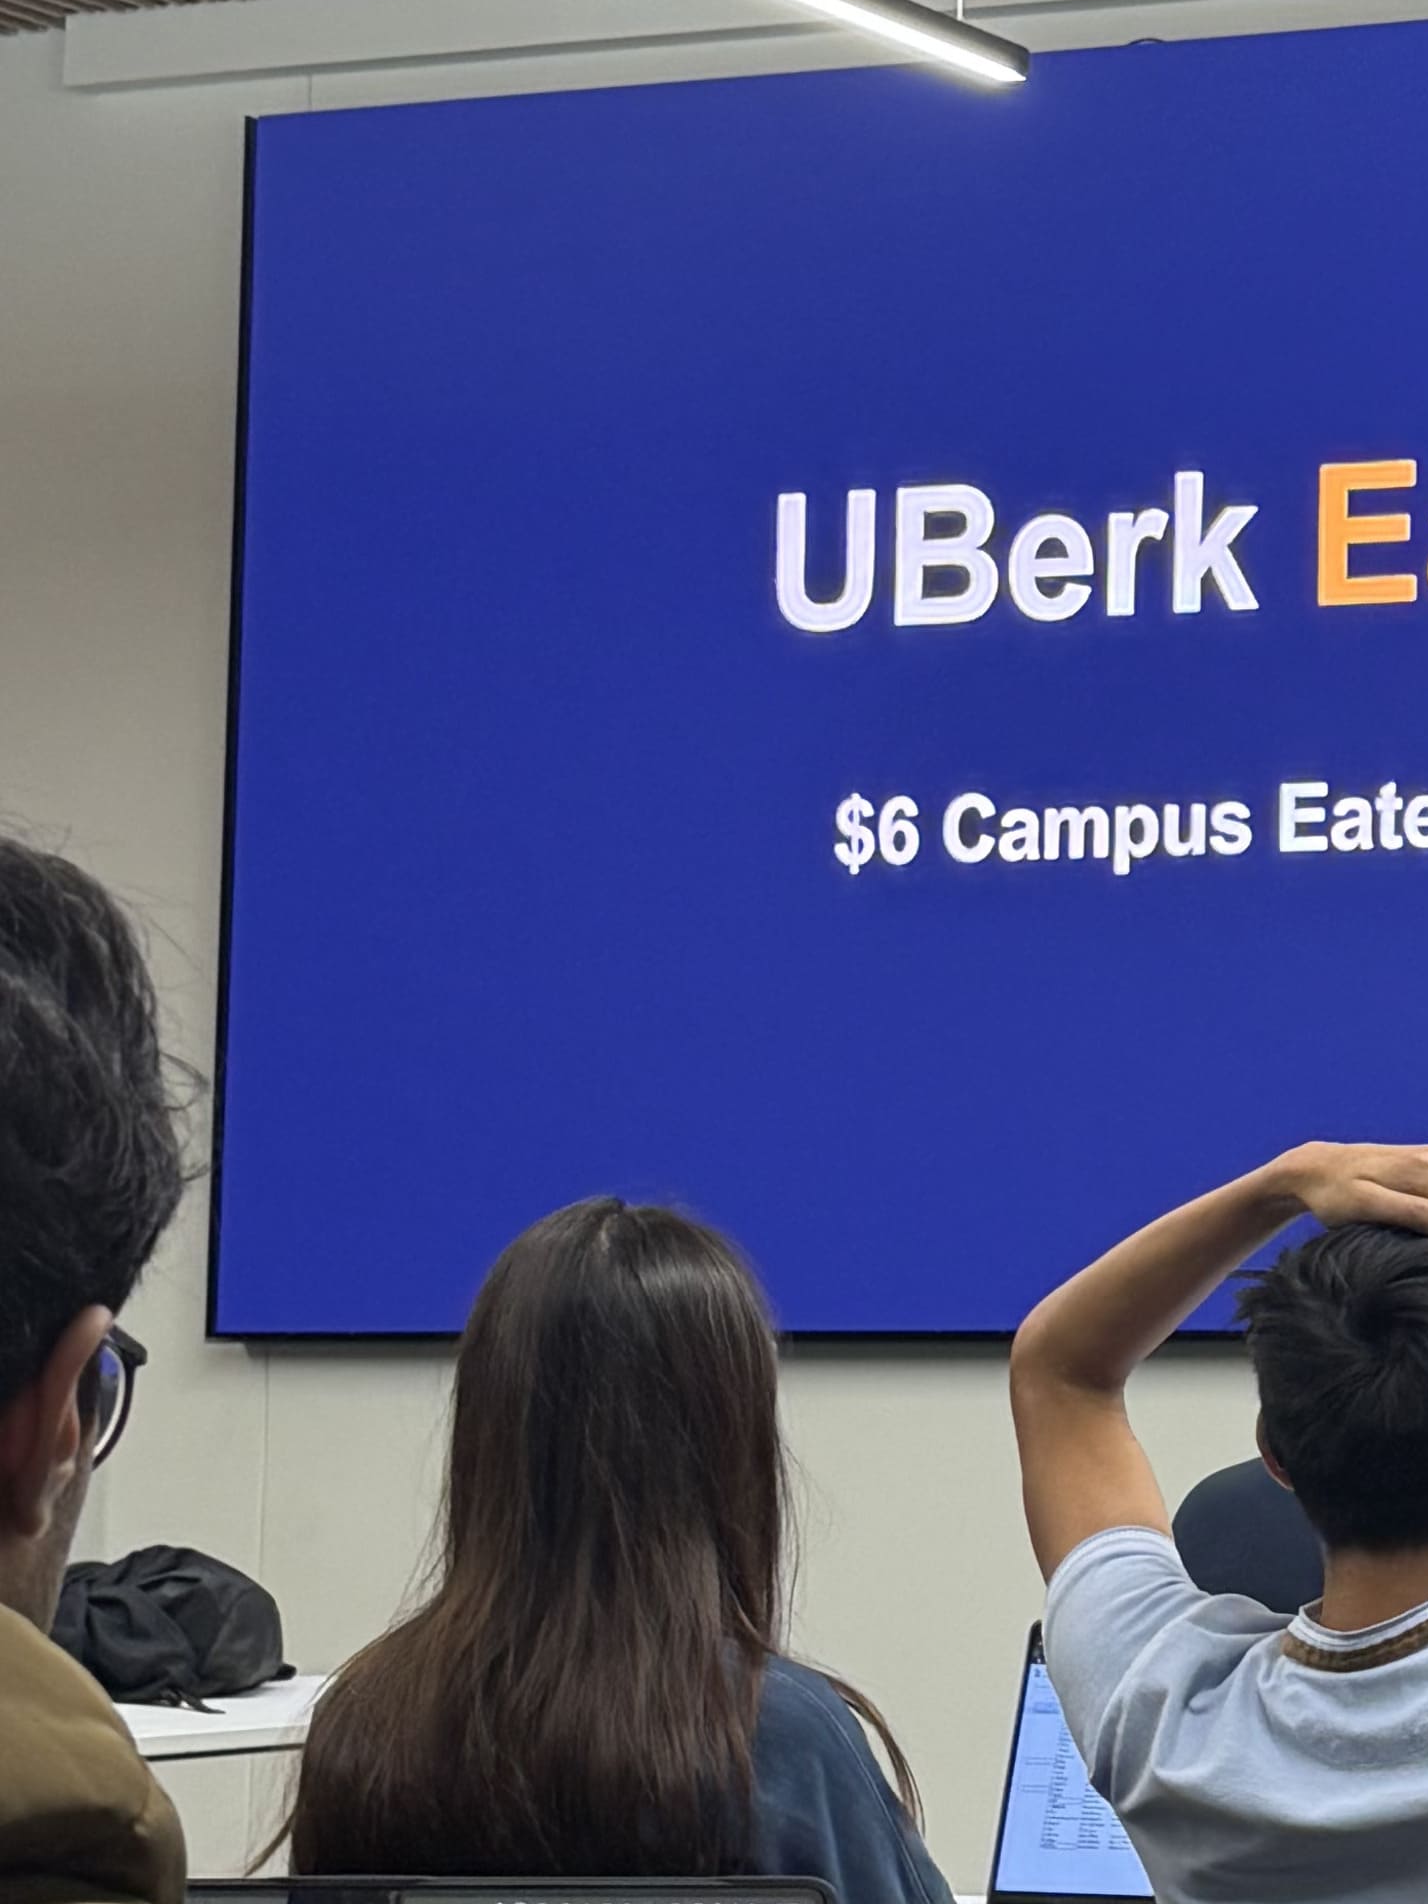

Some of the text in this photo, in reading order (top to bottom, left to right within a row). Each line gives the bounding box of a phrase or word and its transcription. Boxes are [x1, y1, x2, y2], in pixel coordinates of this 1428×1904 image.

[775, 470, 1260, 633] UBerk
[833, 792, 920, 875] $6
[942, 792, 1253, 875] Campus
